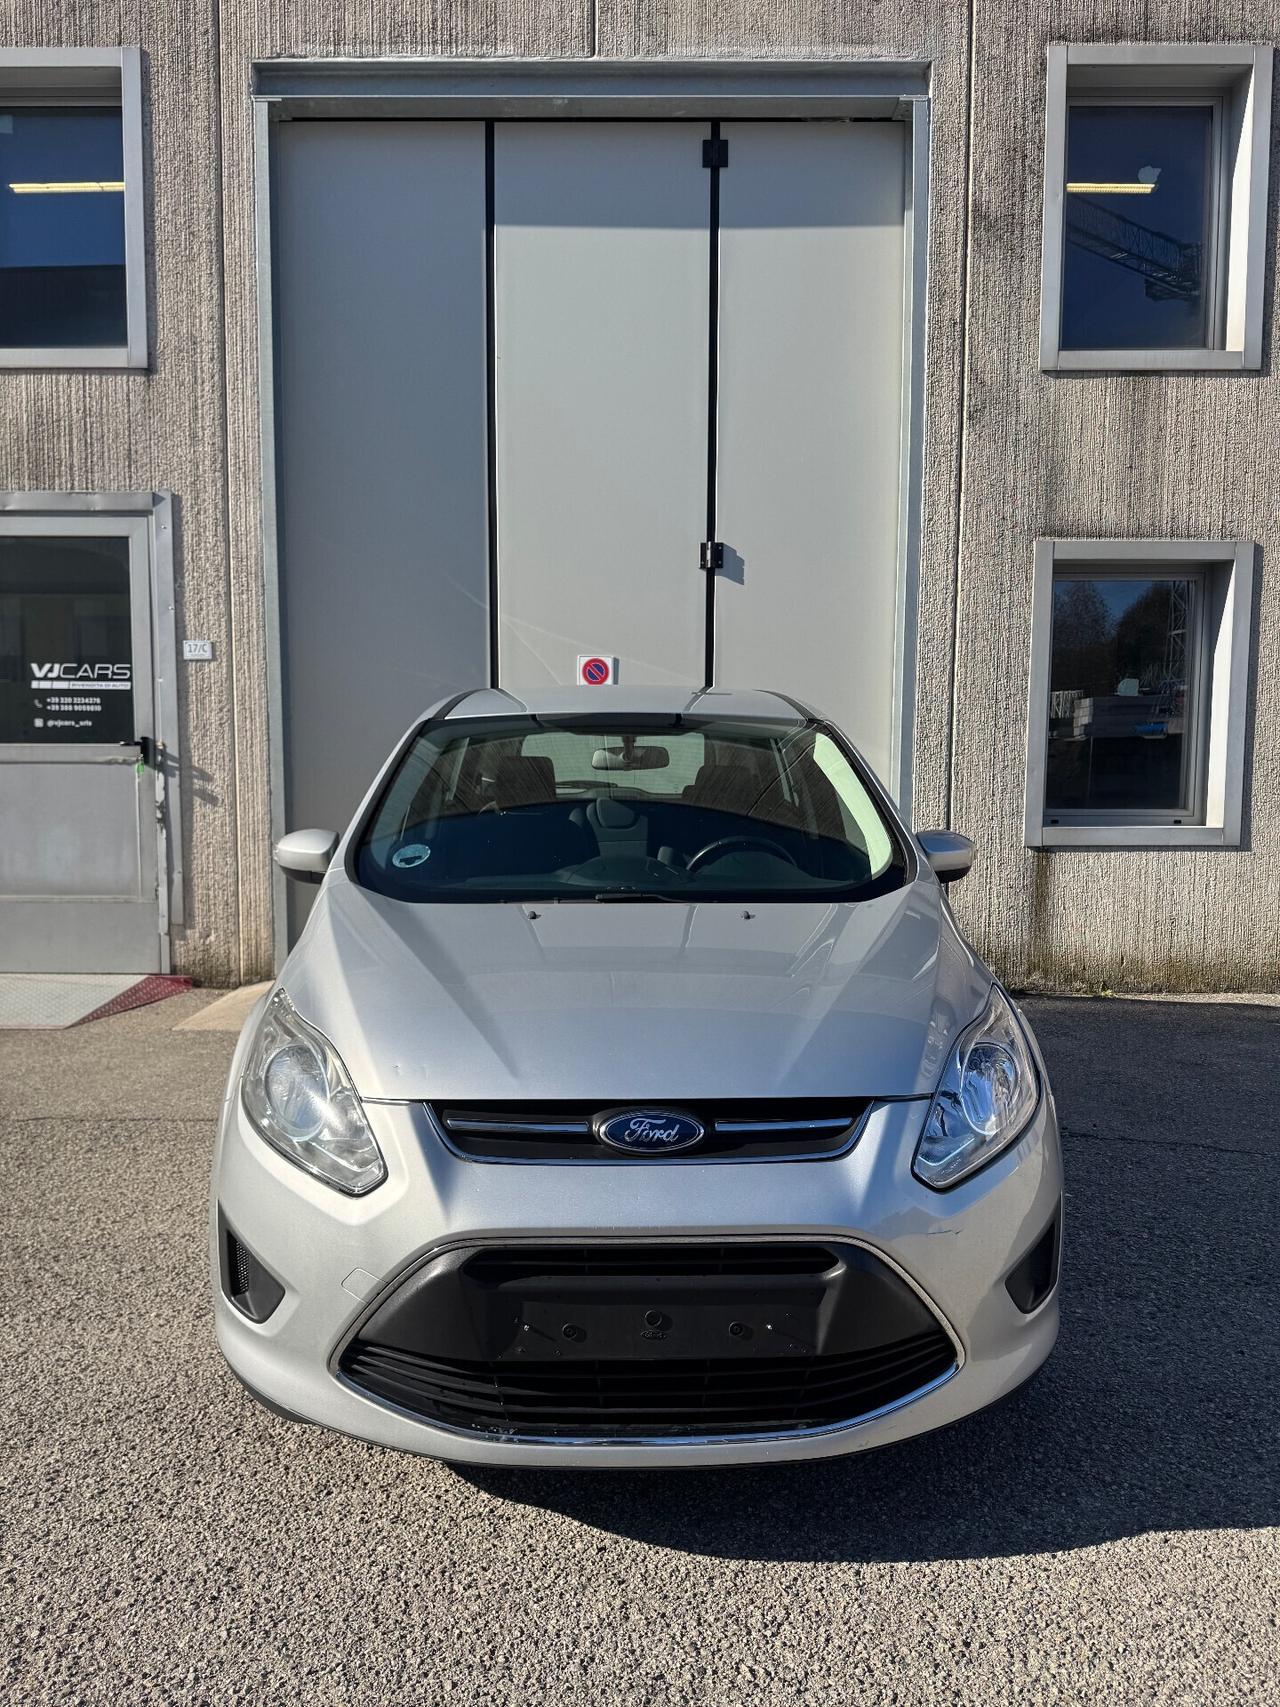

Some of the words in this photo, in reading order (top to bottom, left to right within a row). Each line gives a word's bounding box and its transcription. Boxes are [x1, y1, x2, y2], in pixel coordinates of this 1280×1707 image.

[188, 643, 208, 653] 17/C
[30, 663, 132, 679] VJCARS
[624, 1117, 680, 1142] Ford
